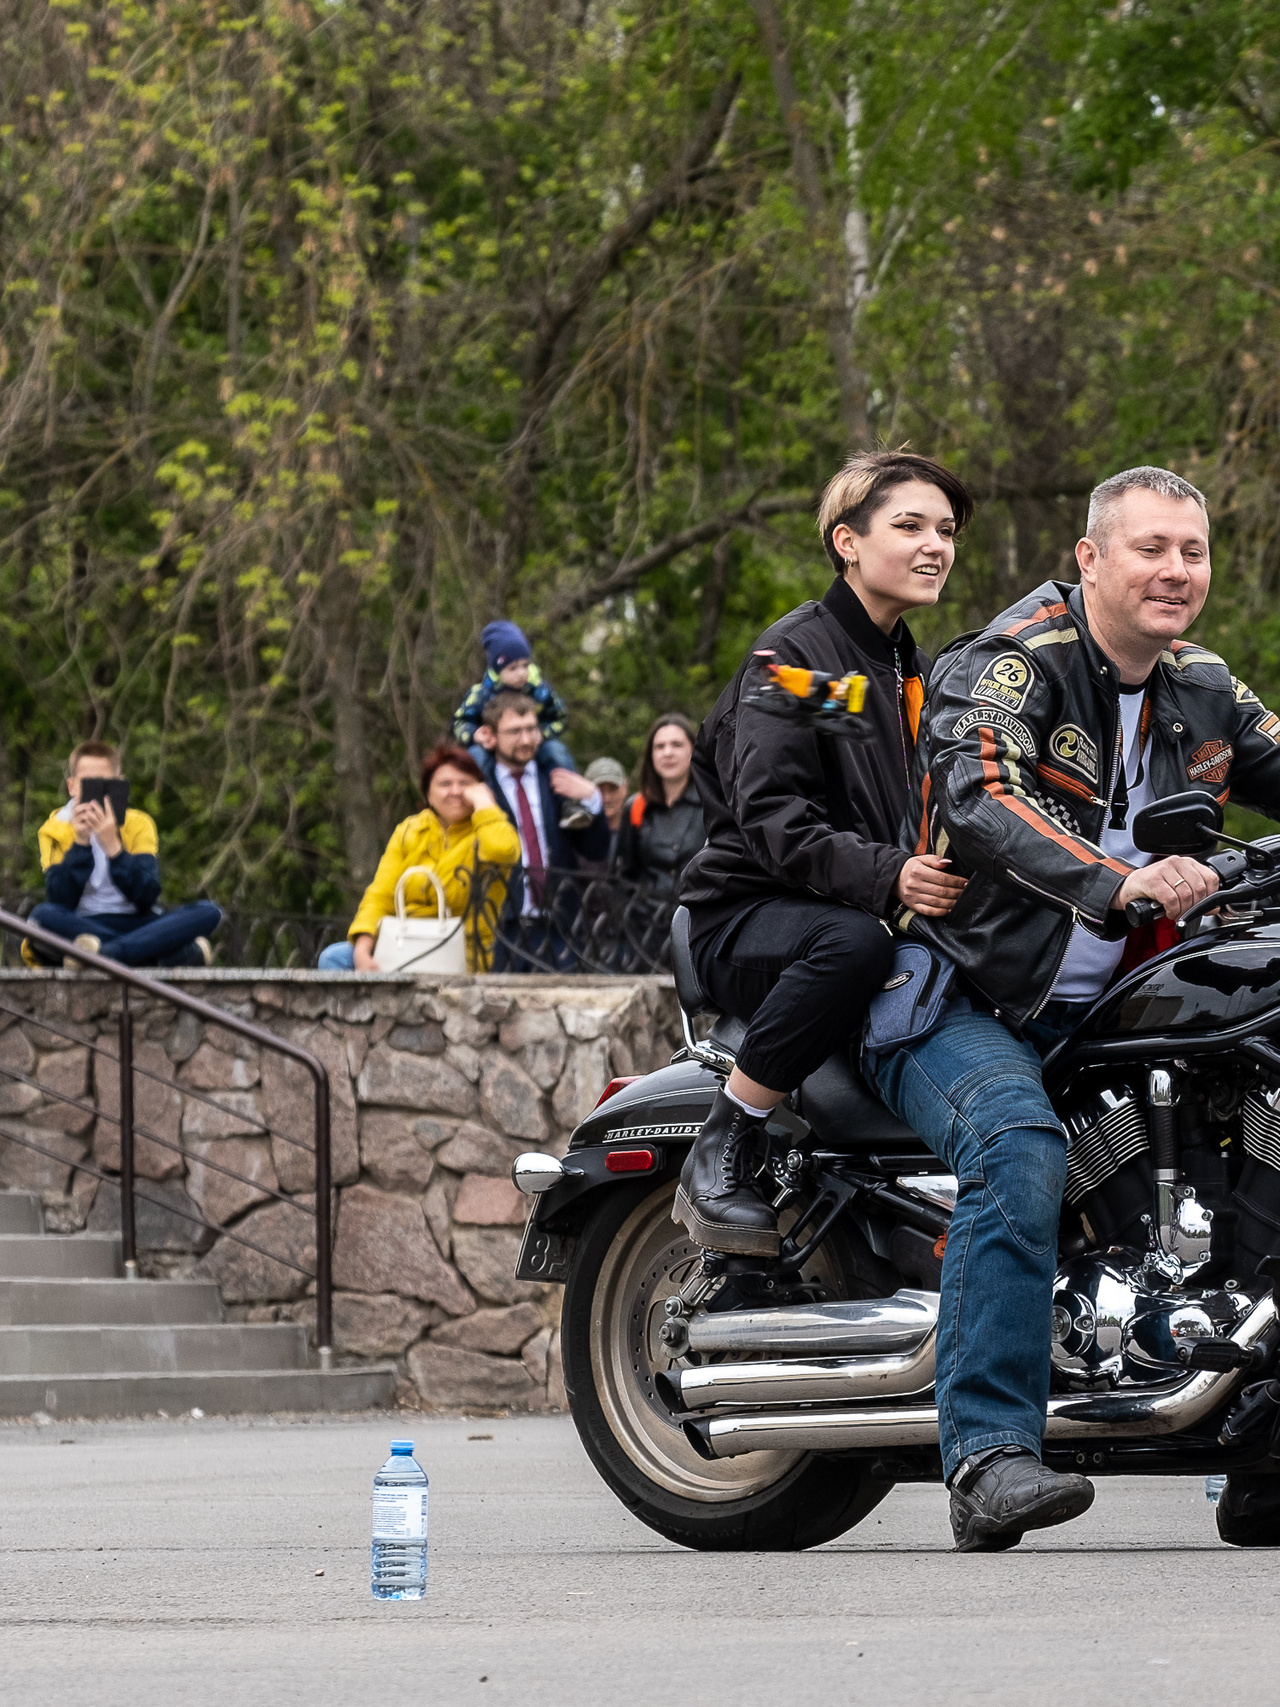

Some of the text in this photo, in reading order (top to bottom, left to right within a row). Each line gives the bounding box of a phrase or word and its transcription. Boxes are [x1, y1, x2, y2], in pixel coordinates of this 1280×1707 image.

[996, 663, 1024, 682] 26
[1196, 743, 1220, 760] MOTOR
[1189, 747, 1233, 777] HARLEY-DAVIDSON
[606, 1126, 702, 1140] HARLEY-DAVIDS
